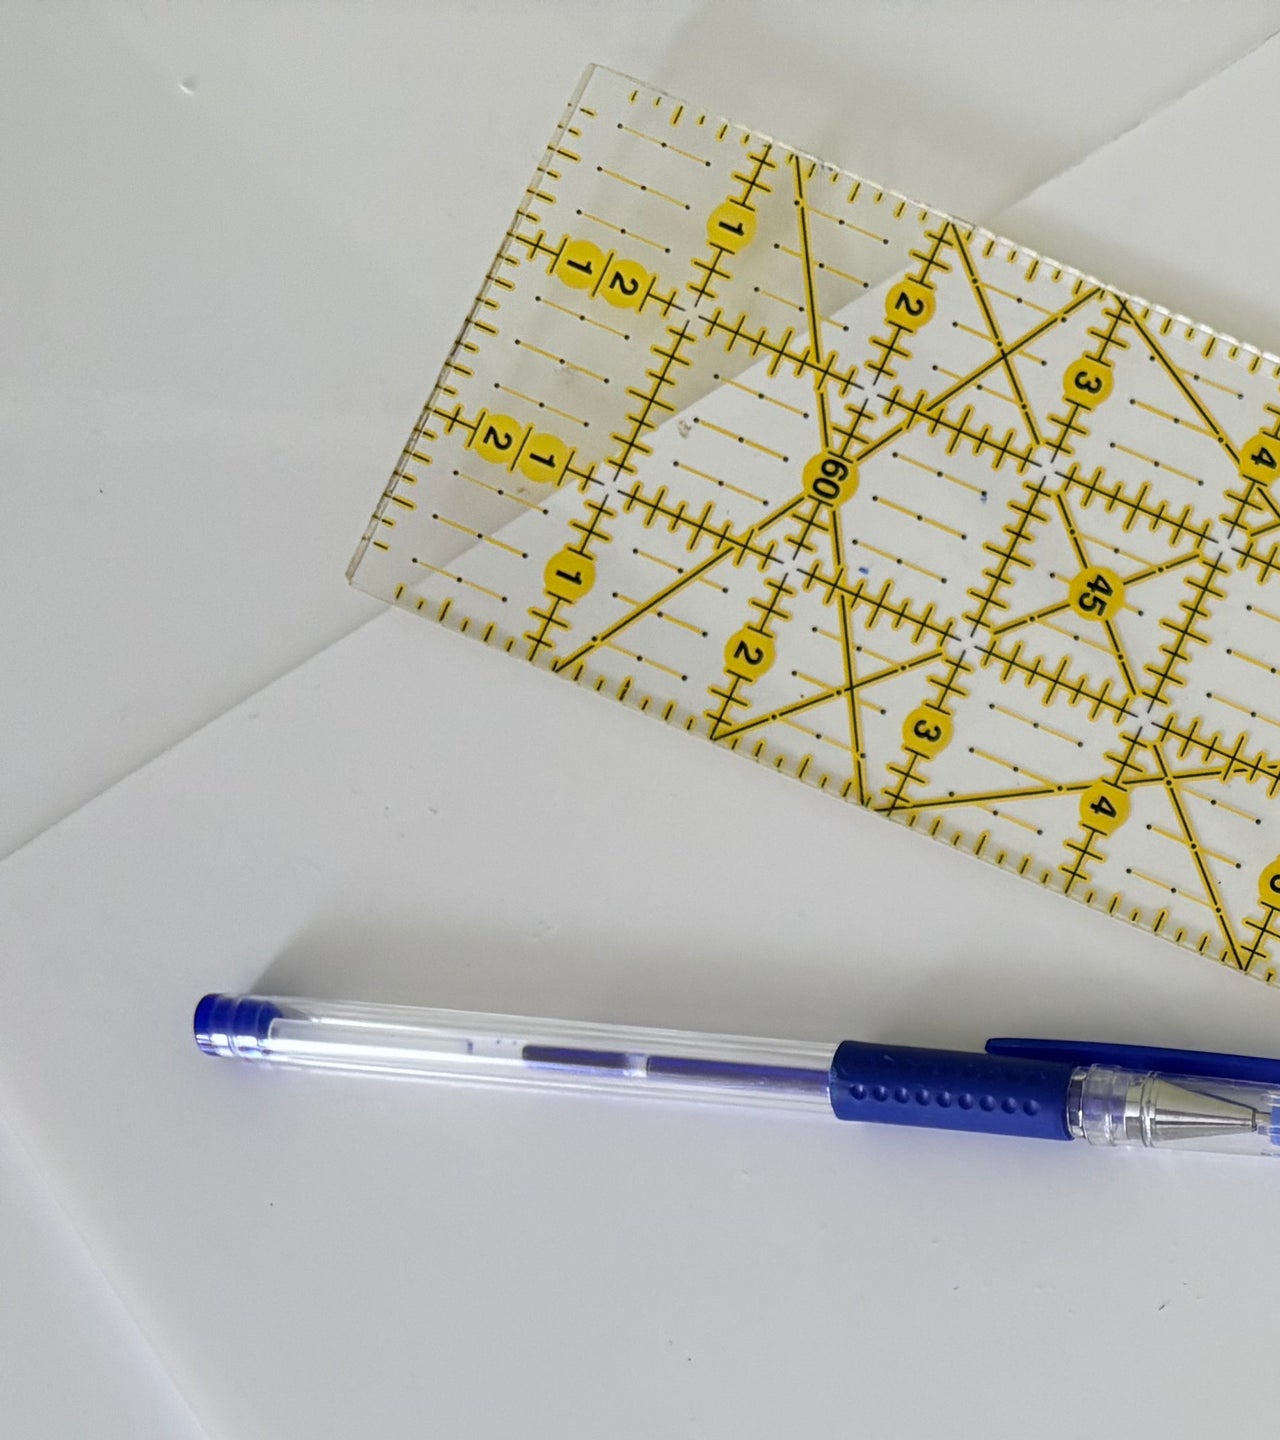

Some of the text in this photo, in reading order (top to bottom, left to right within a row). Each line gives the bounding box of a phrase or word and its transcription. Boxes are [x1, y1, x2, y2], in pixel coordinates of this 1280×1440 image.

[718, 221, 745, 237] 1
[566, 259, 593, 275] 1
[609, 271, 639, 296] 2
[894, 291, 925, 317] 2
[1074, 371, 1103, 394] 3
[482, 425, 513, 451] 2
[529, 452, 556, 468] 1
[1250, 446, 1277, 470] 4
[812, 458, 849, 500] 60
[555, 569, 583, 586] 1
[1078, 574, 1114, 617] 45
[733, 640, 764, 666] 2
[913, 719, 942, 742] 3
[1089, 795, 1117, 818] 4
